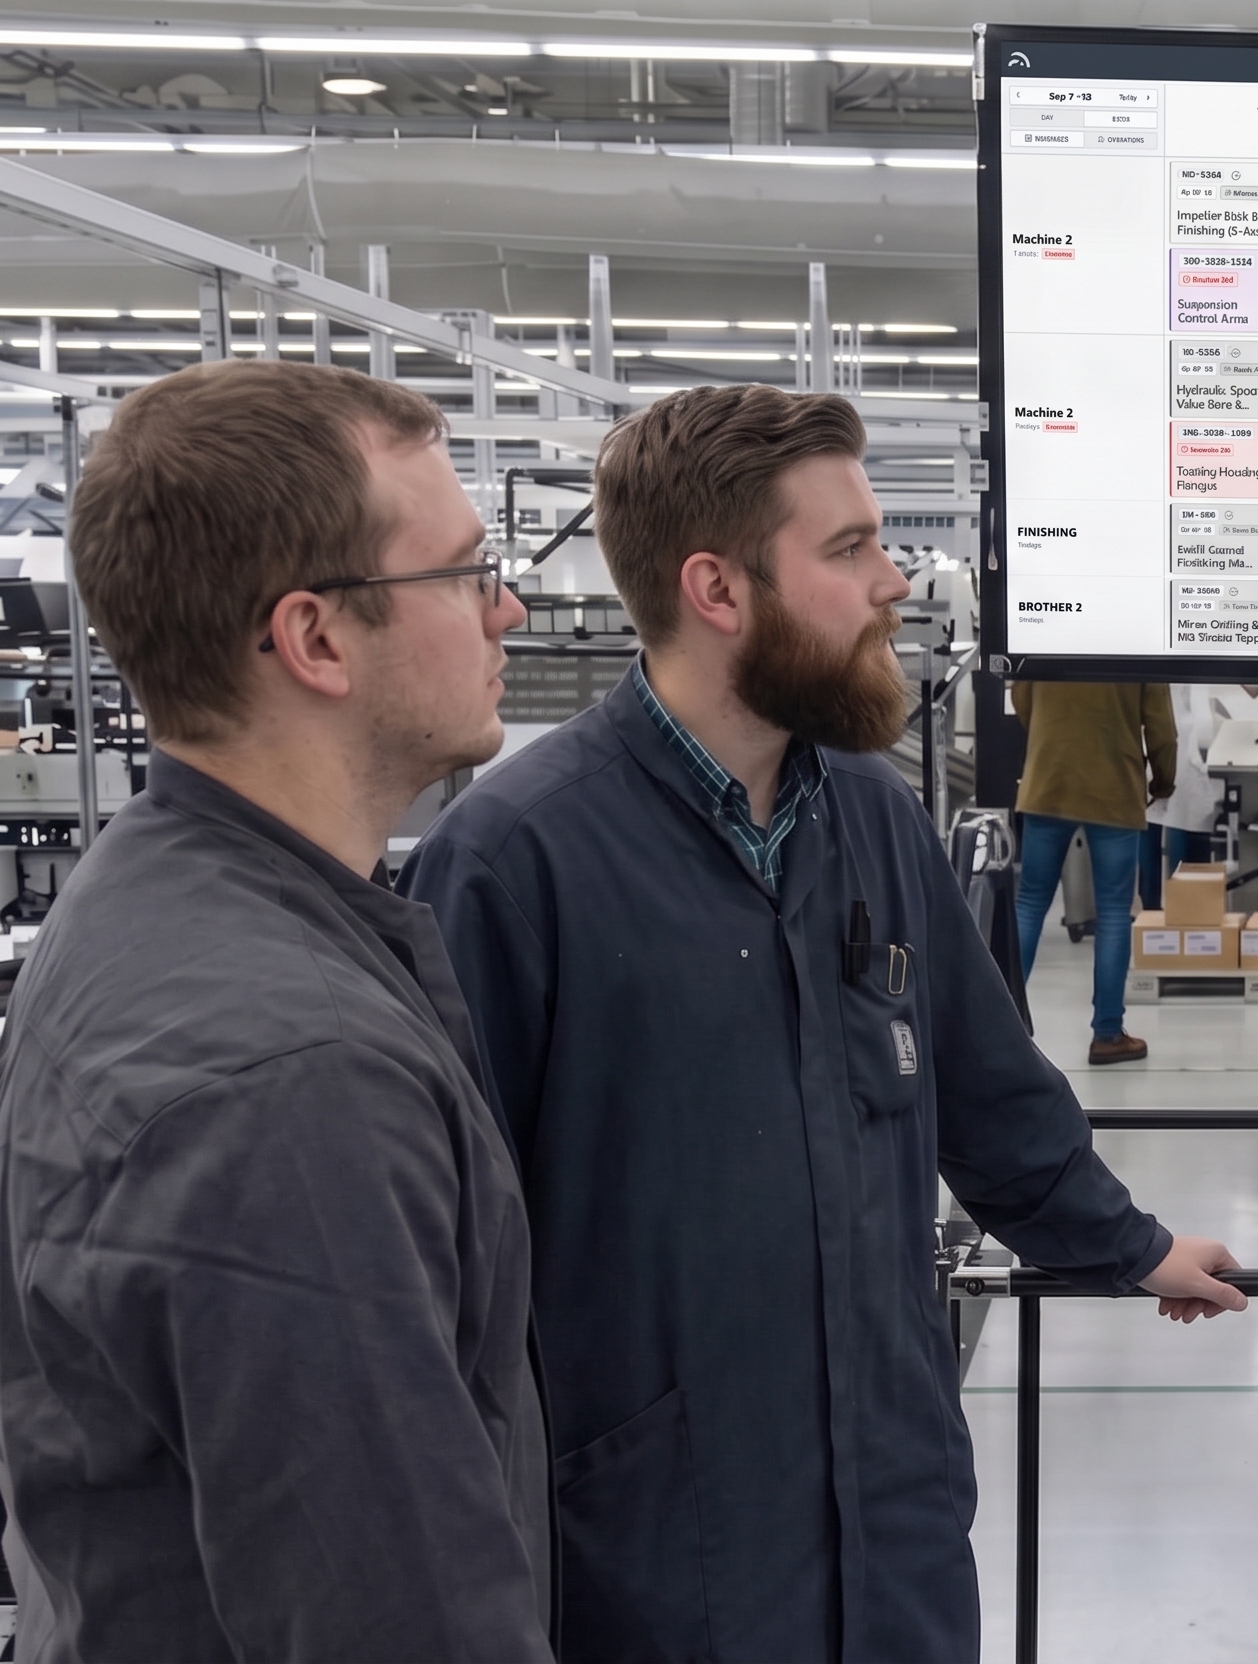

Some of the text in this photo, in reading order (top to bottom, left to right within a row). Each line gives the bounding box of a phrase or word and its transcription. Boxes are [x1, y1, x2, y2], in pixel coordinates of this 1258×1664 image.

[1049, 92, 1066, 102] Sep
[1177, 225, 1224, 238] Finishing
[1012, 234, 1073, 245] Machine 2
[1178, 313, 1217, 323] Control
[1014, 407, 1073, 418] Machine 2
[1018, 527, 1077, 537] FINISHING
[1019, 602, 1082, 612] BROTHER 2
